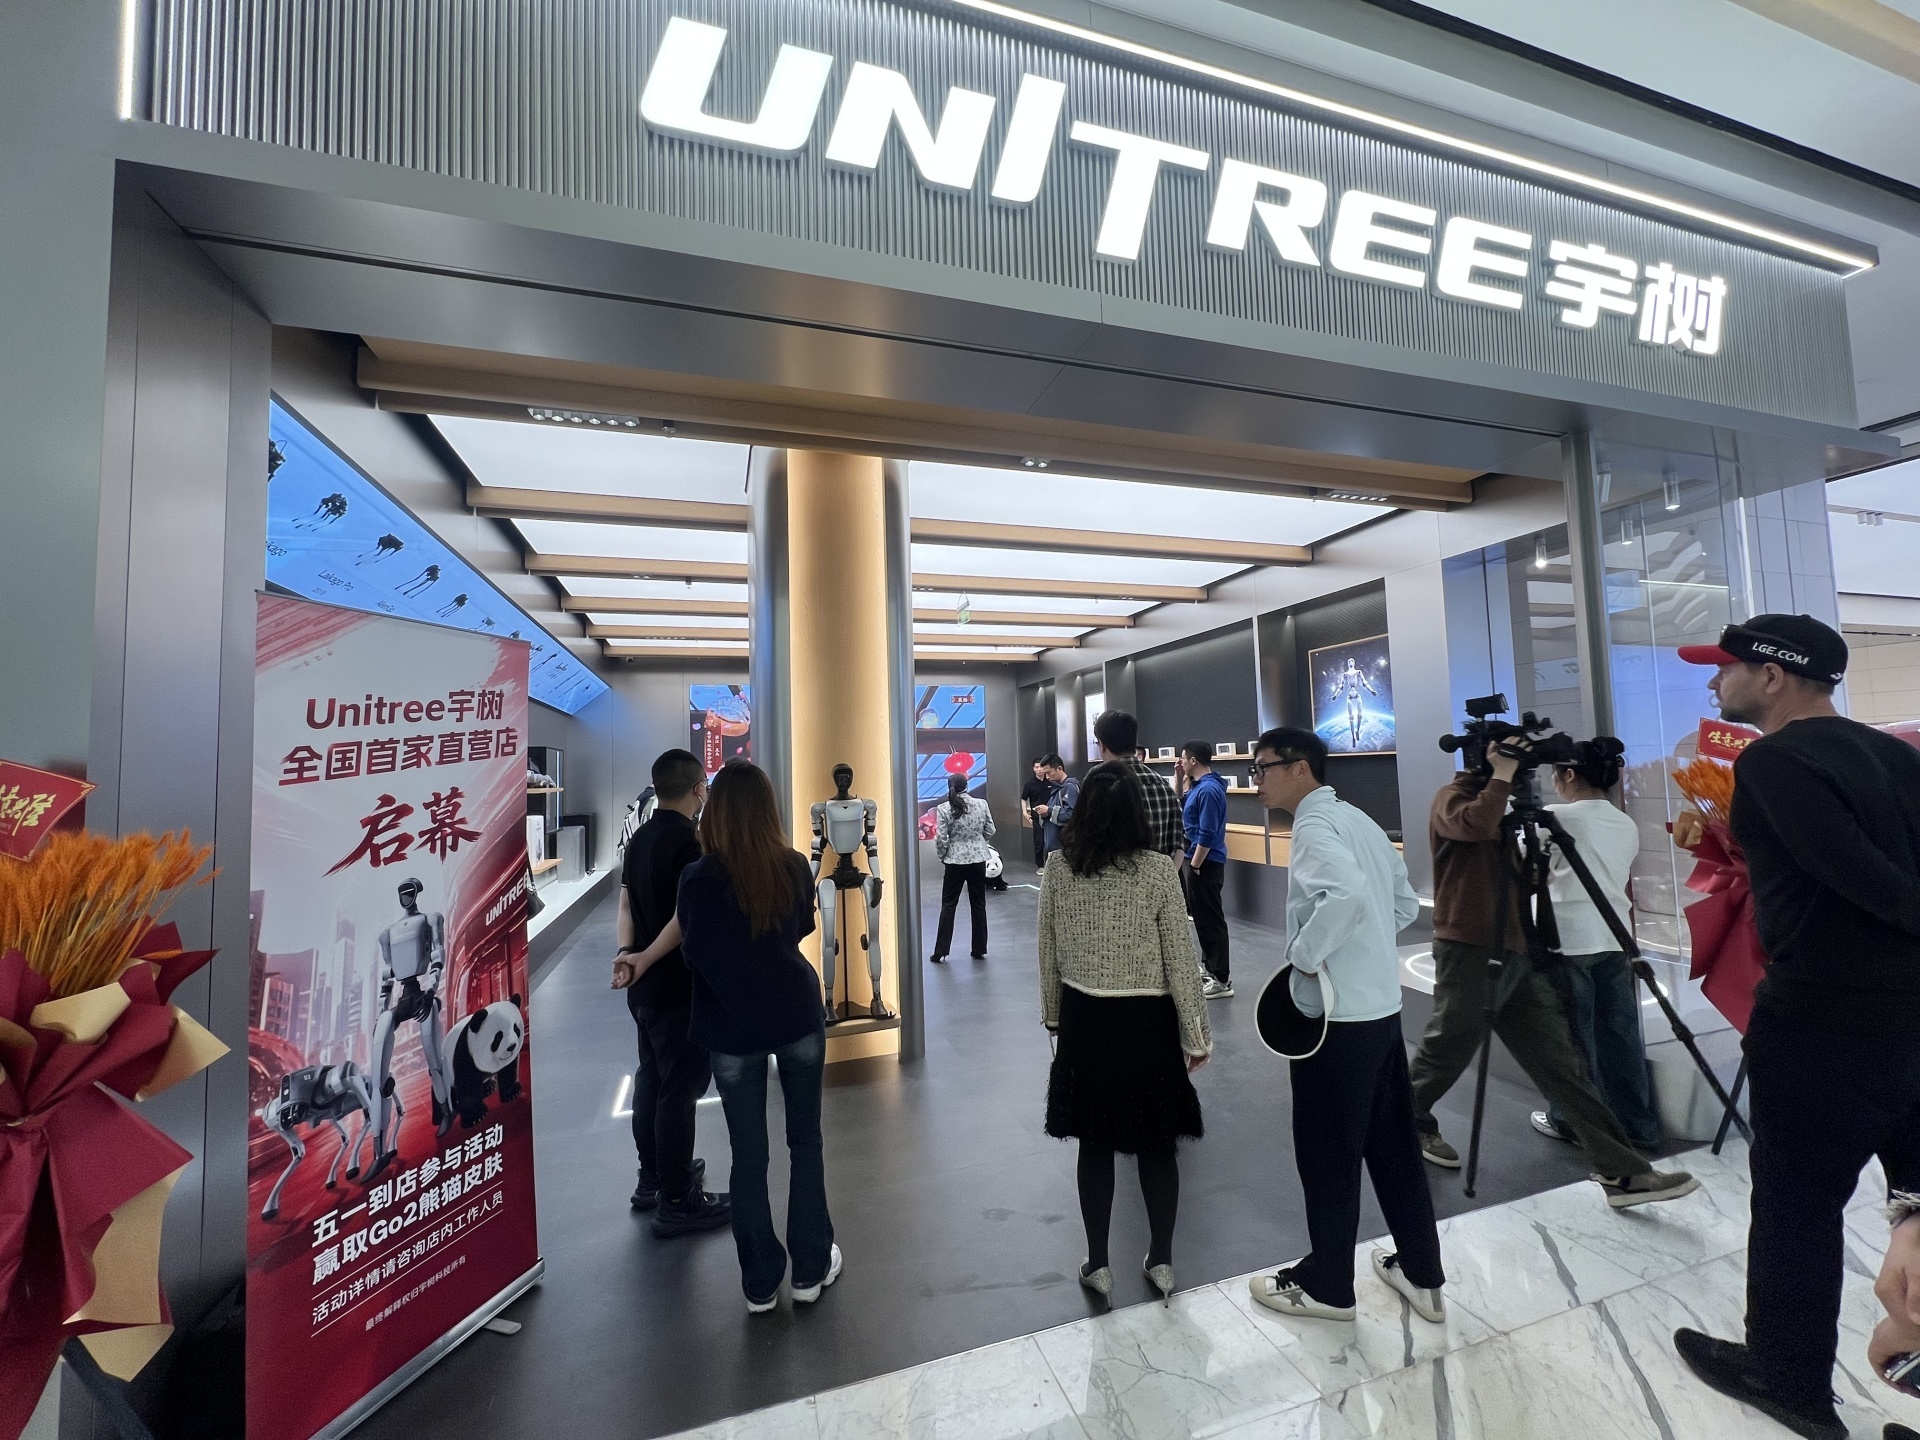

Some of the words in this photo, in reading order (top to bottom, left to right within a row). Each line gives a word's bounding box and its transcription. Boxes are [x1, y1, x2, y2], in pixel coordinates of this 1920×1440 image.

[640, 16, 1533, 310] UNITREE
[1545, 239, 1727, 356] 宇树
[1752, 642, 1810, 665] LGE.COM
[278, 727, 518, 787] 全国首家直营店
[306, 689, 504, 730] Unitree宇树
[322, 787, 483, 878] 启幕
[312, 1123, 504, 1248] 五一到店参与活动
[312, 1152, 504, 1285] 赢取Go2熊猫皮肤
[312, 1191, 504, 1325] 活动详情请咨询店内工作人员
